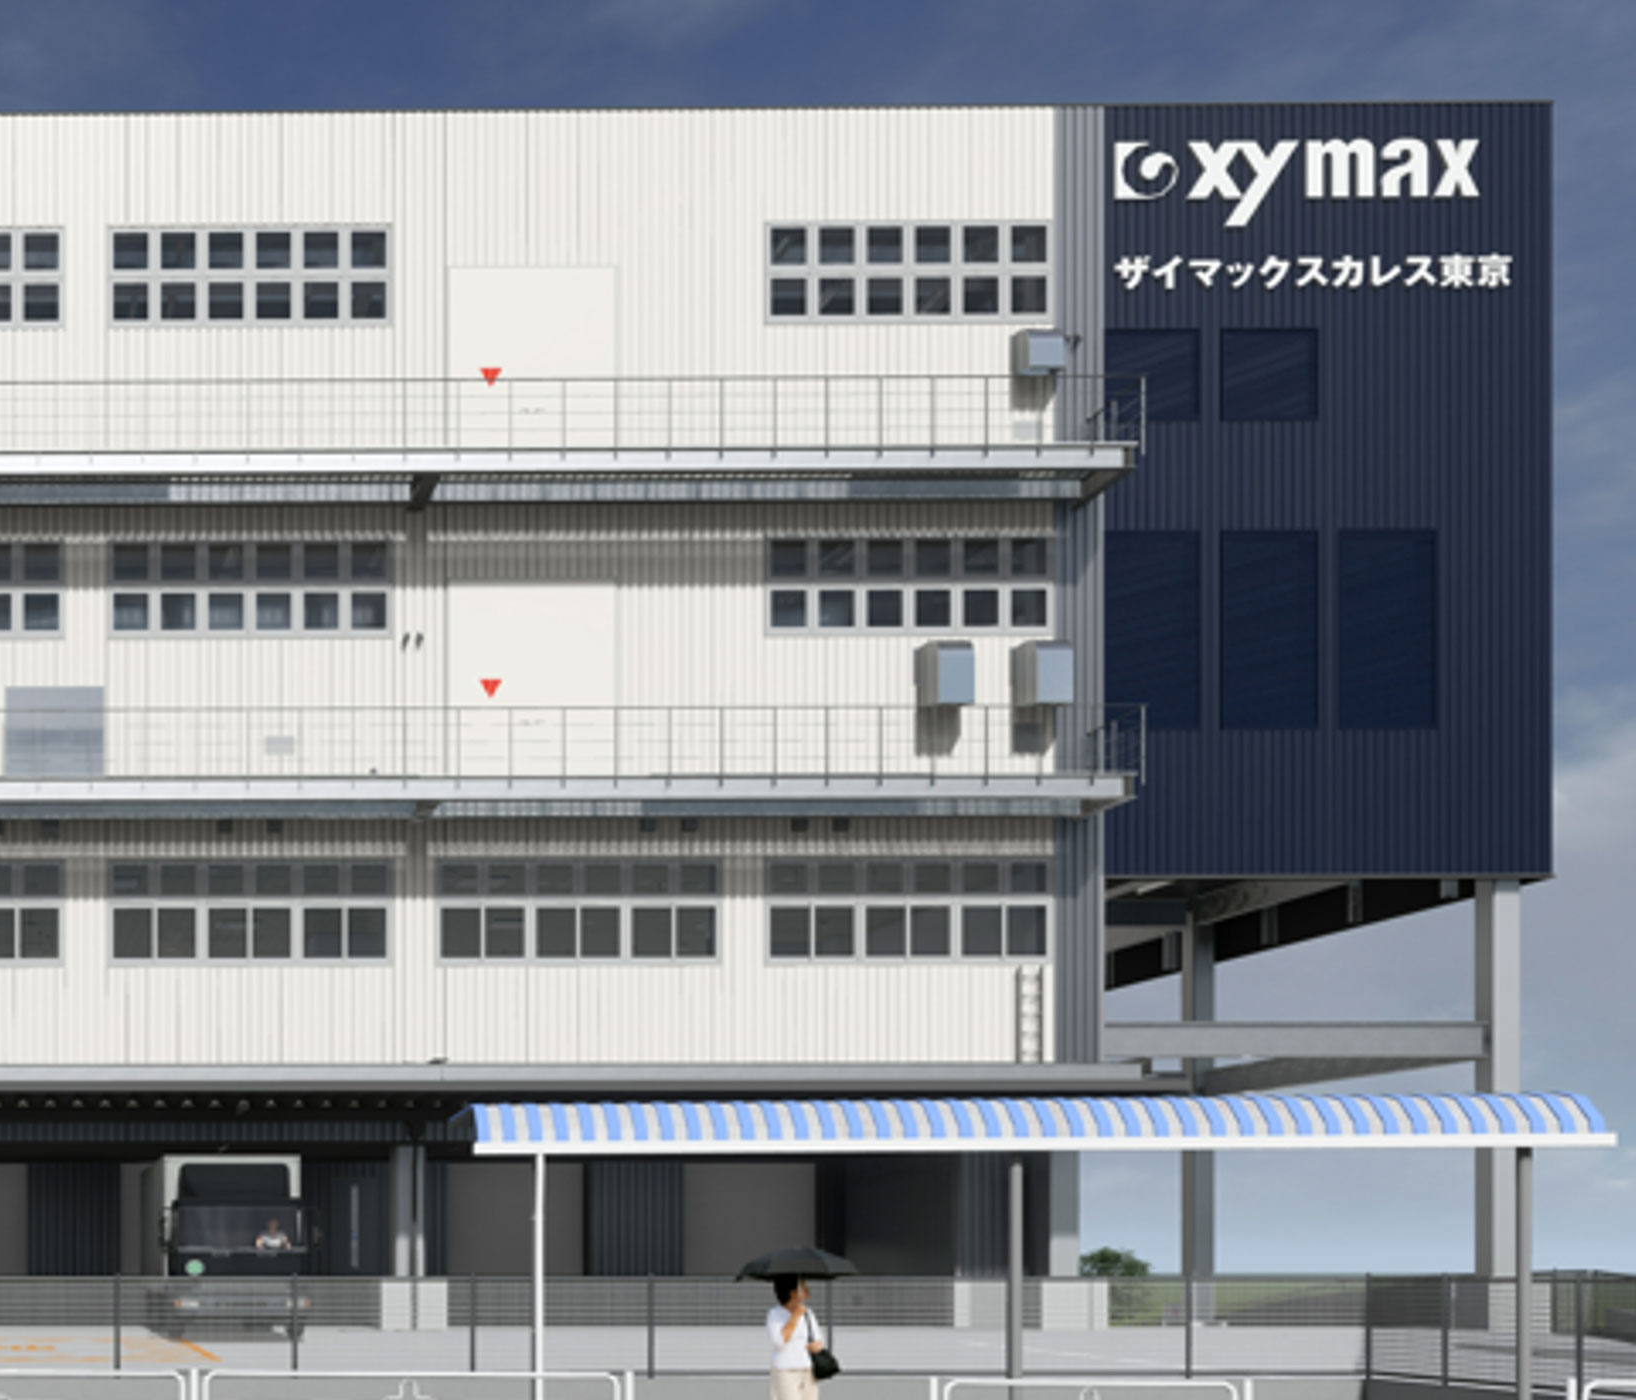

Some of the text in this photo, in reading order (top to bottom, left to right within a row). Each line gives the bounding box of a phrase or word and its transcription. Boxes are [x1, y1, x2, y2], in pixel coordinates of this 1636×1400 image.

[1186, 138, 1480, 227] xymax
[1113, 254, 1513, 289] ザイマックスカレス東京
